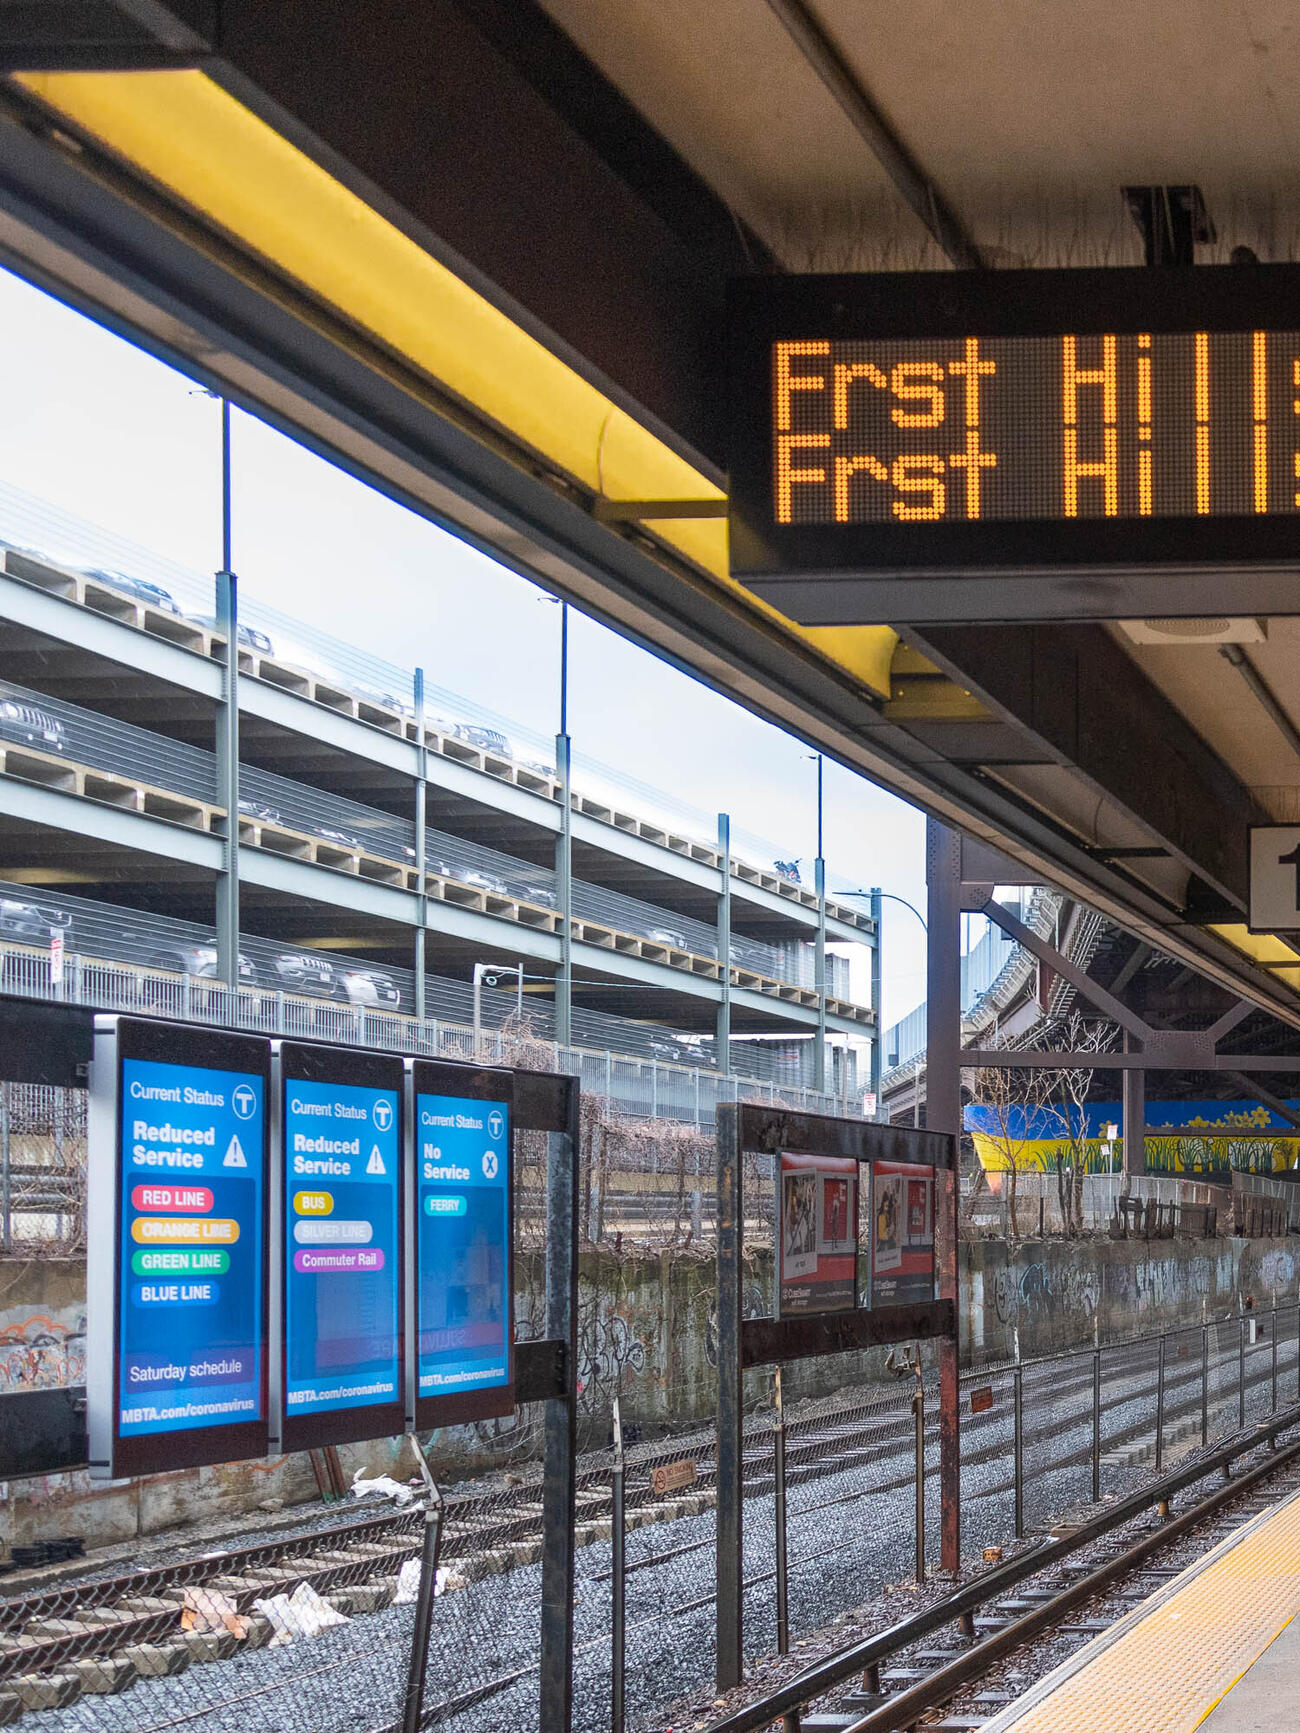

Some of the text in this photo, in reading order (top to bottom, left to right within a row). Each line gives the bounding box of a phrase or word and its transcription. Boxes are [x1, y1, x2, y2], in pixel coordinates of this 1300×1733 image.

[774, 337, 996, 430] Frst
[774, 431, 997, 523] Frst
[130, 1081, 181, 1102] Current
[183, 1087, 224, 1107] Status
[291, 1099, 332, 1116] Current
[334, 1103, 367, 1119] Status
[422, 1111, 454, 1127] Current
[456, 1114, 483, 1129] Status
[133, 1120, 215, 1146] Reduced
[294, 1134, 360, 1155] Reduced
[424, 1143, 441, 1159] No
[132, 1144, 204, 1168] Service
[294, 1156, 351, 1175] Service
[424, 1163, 470, 1180] Service
[142, 1189, 205, 1206] RED LINE
[302, 1196, 325, 1209] BUS
[430, 1199, 459, 1211] FERRY
[142, 1222, 231, 1238] ORANGE LINE
[302, 1225, 366, 1238] SILVER LINE
[141, 1254, 221, 1269] GREEN LINE
[302, 1252, 377, 1267] Commuter Rail
[141, 1285, 211, 1301] BLUE LINE
[130, 1360, 242, 1382] Saturday schedule
[419, 1367, 505, 1388] MBTA.com/coronavirus
[288, 1381, 393, 1404] MBTA.com/coronavirus
[121, 1399, 254, 1423] MBTA.com/coronavirus
